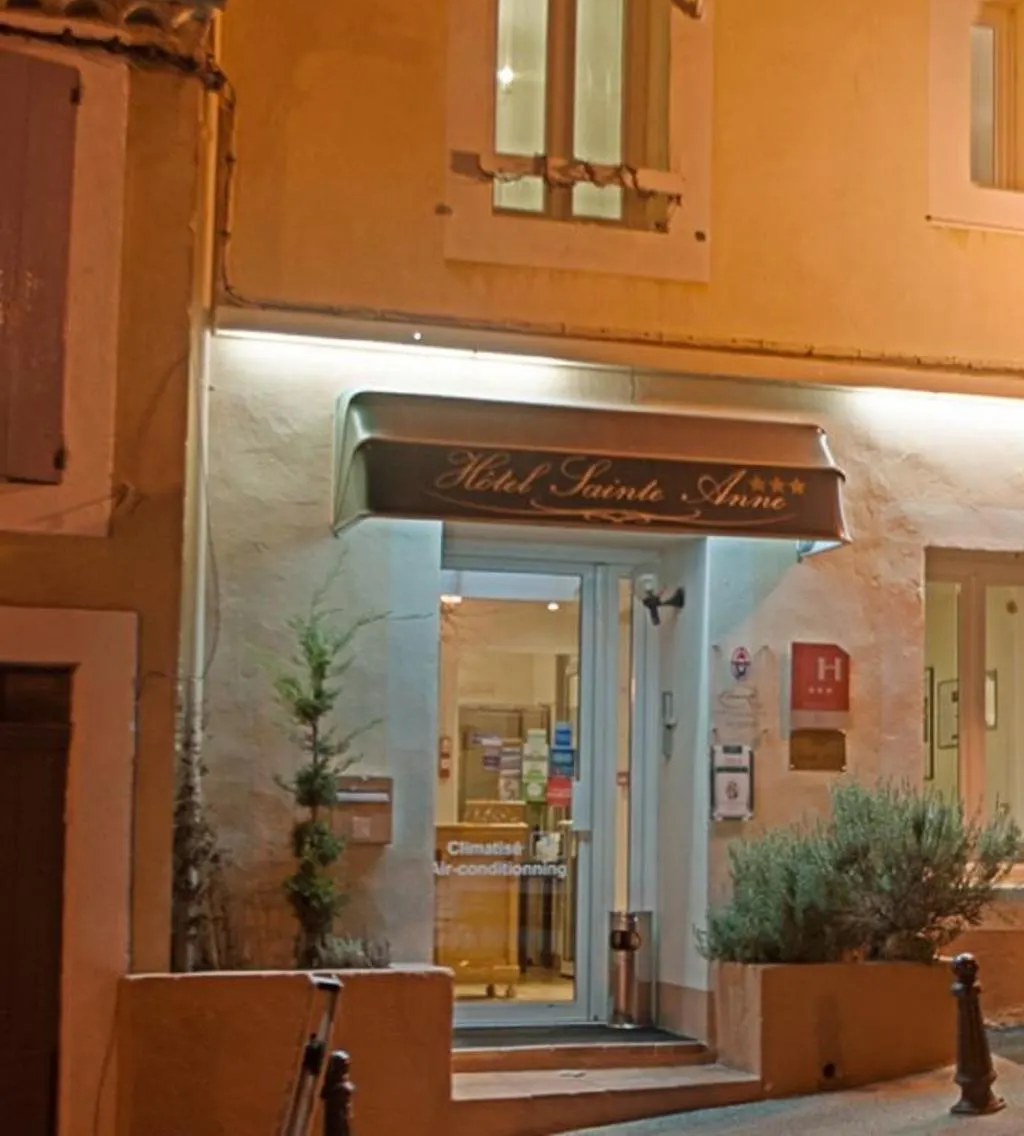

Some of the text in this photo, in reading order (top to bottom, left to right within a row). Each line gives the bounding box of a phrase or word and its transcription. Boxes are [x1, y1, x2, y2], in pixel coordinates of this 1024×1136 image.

[435, 451, 787, 510] Hôtel Sainte Anne
[817, 656, 842, 682] H
